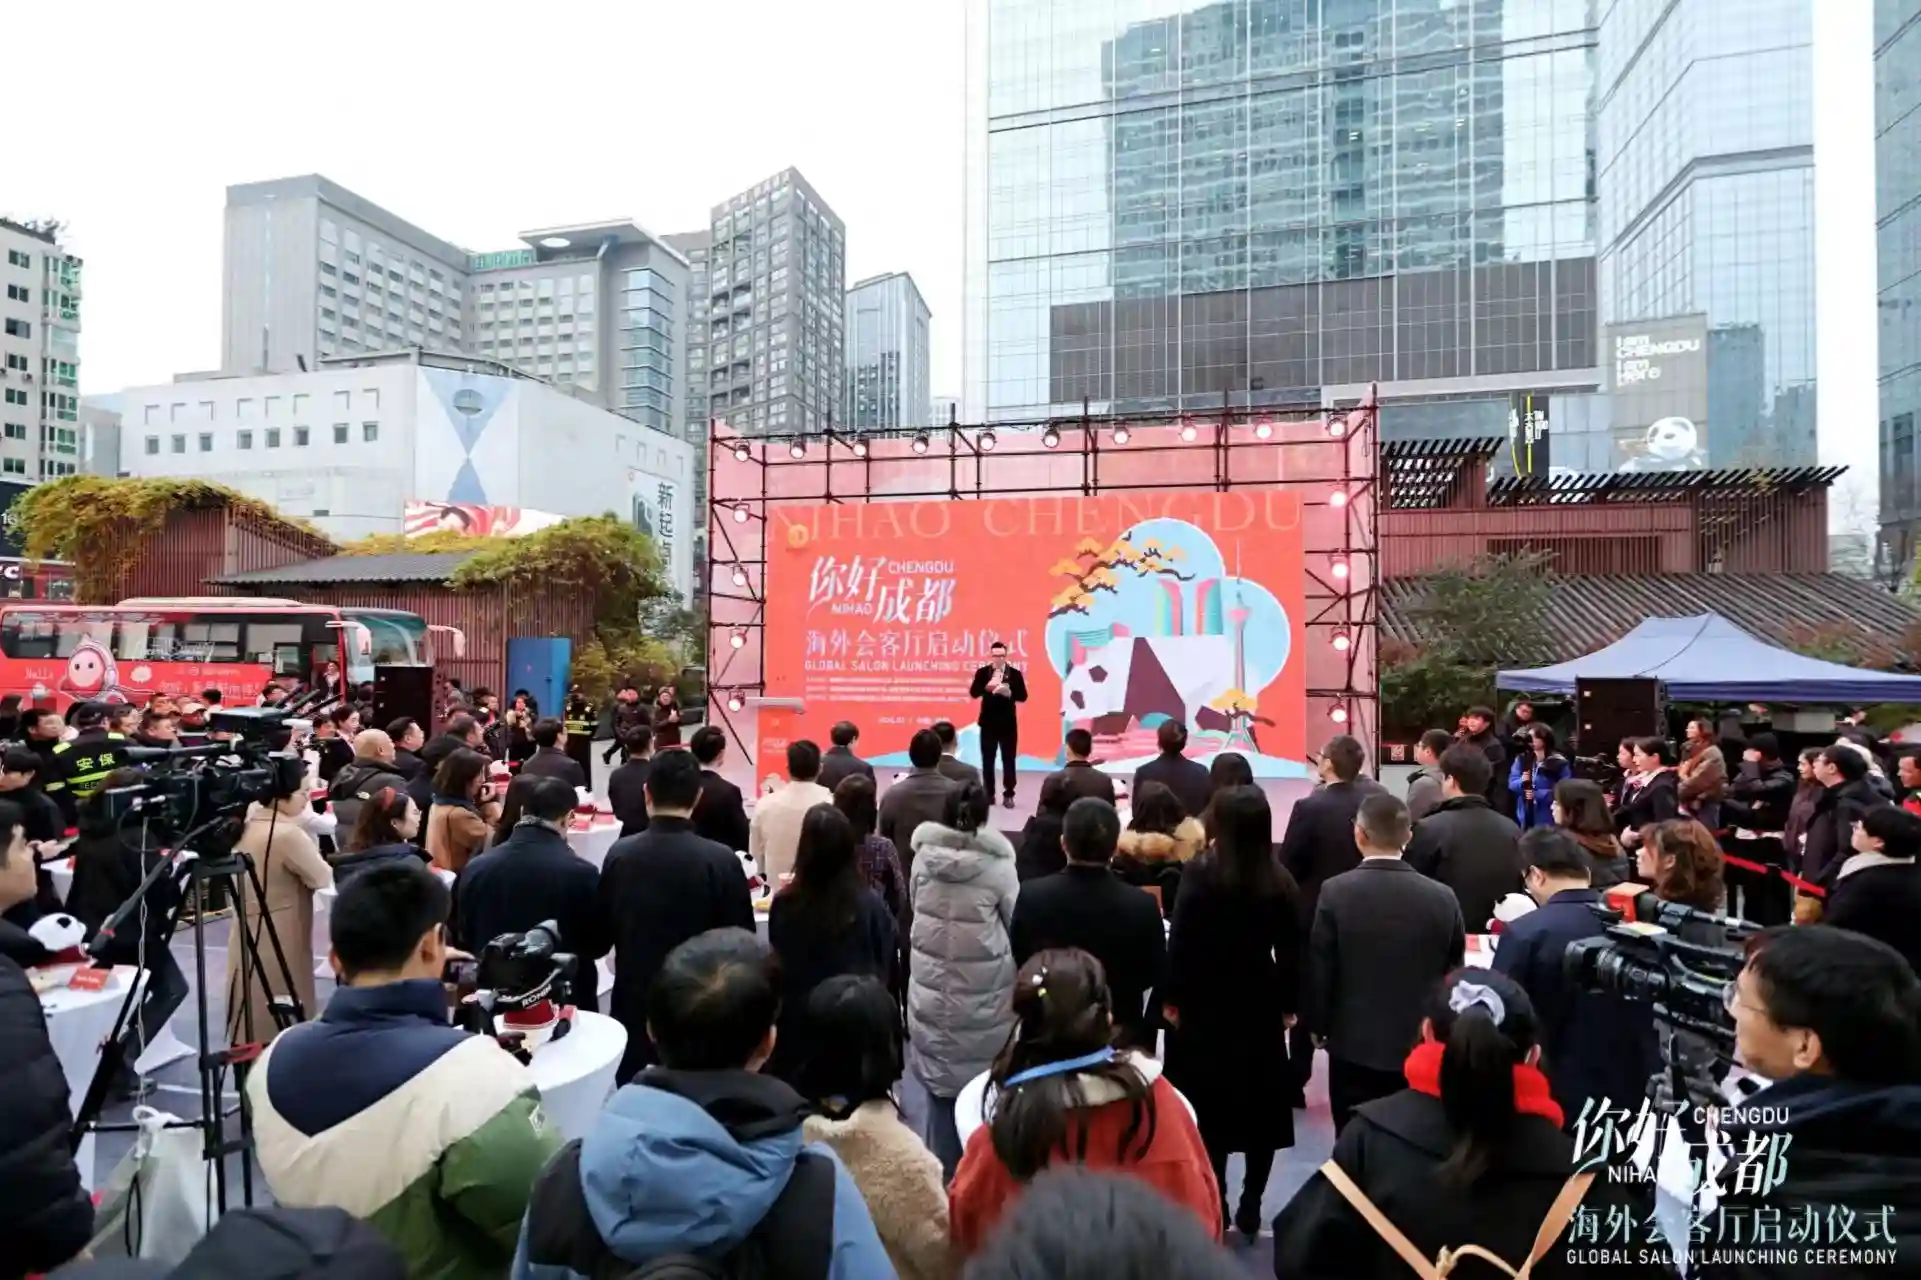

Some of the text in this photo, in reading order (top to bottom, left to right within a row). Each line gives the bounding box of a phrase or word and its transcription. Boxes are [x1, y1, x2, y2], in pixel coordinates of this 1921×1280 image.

[888, 560, 954, 574] CHENGDU
[806, 555, 887, 620] 你好
[831, 602, 873, 616] NIHAO
[873, 576, 957, 624] 成都
[805, 628, 1029, 658] 海外会客厅启动仪式
[804, 660, 1029, 674] GLOBAL SALON LAUNCHING CERNY
[76, 752, 115, 771] 安保
